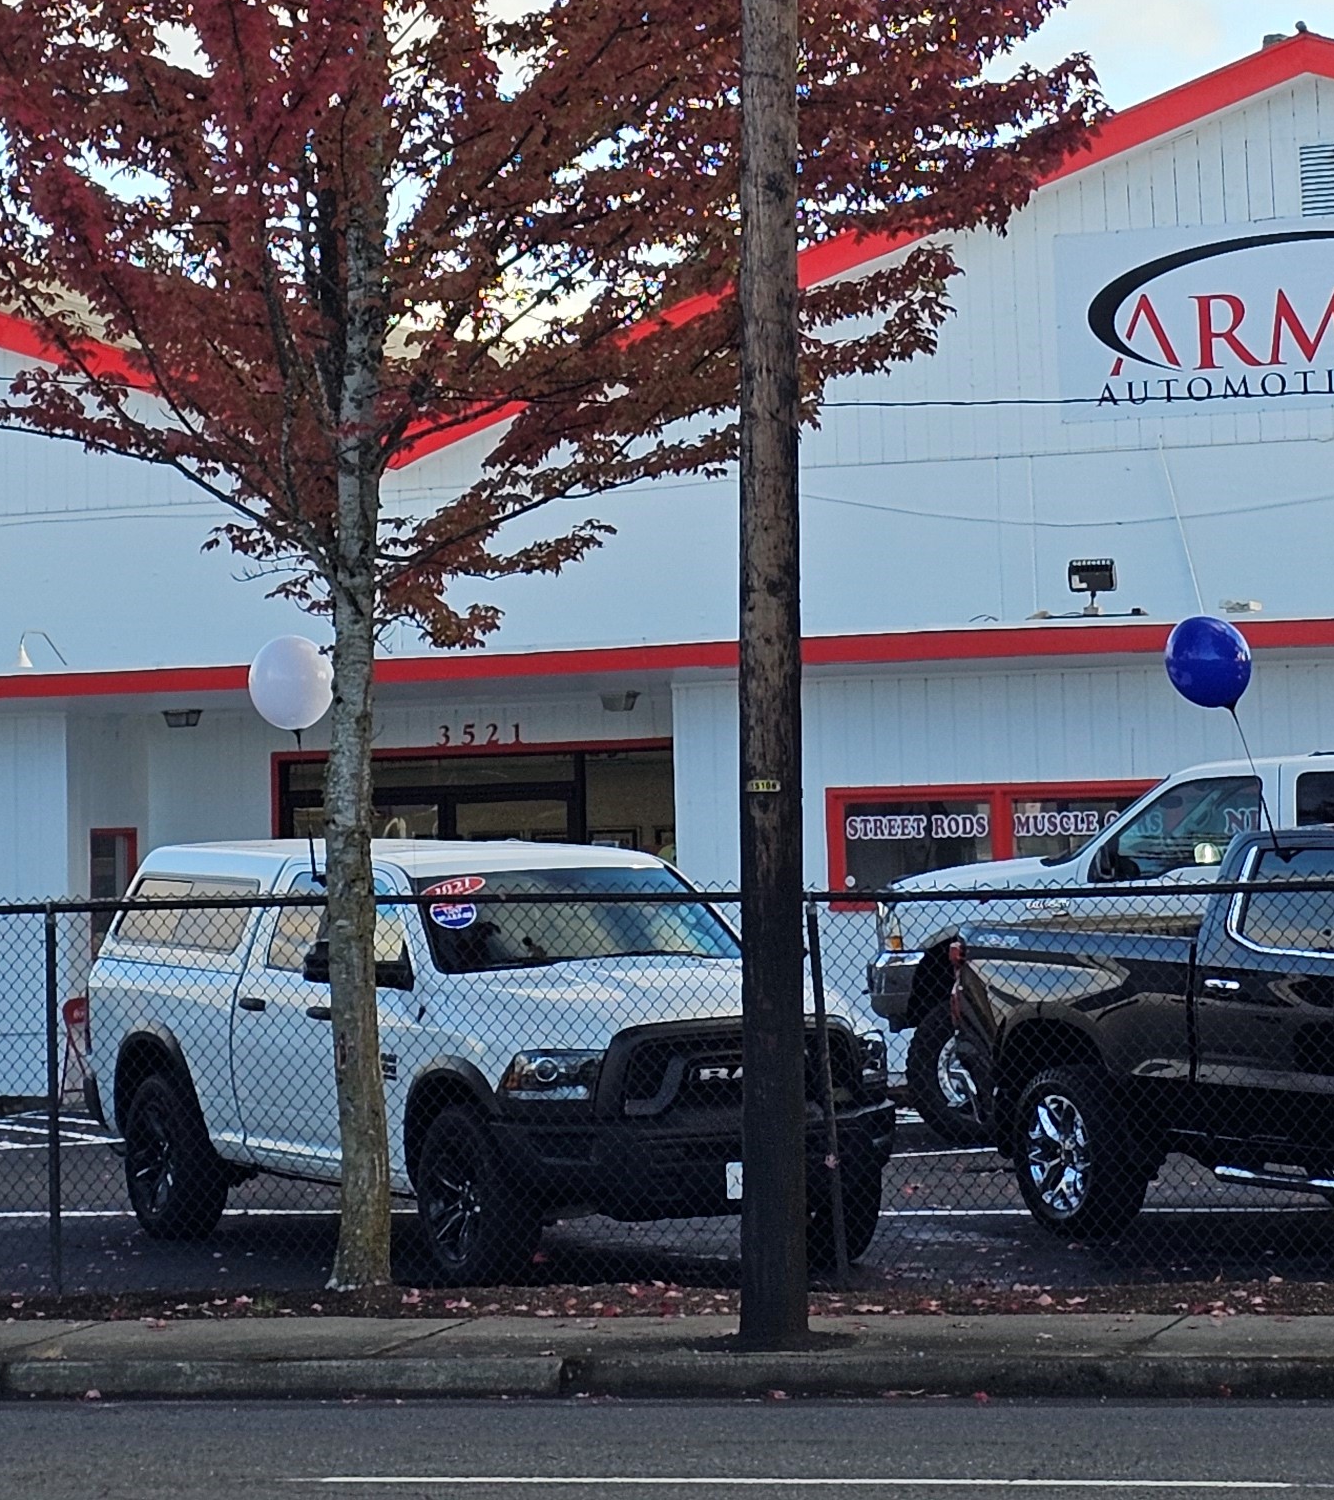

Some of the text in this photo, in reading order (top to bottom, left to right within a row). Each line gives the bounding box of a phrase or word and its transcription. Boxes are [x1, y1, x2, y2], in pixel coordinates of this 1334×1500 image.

[436, 722, 523, 747] 3521
[846, 813, 989, 839] STREET RODS
[1014, 811, 1100, 836] MUSCLE
[700, 1066, 744, 1080] RA
